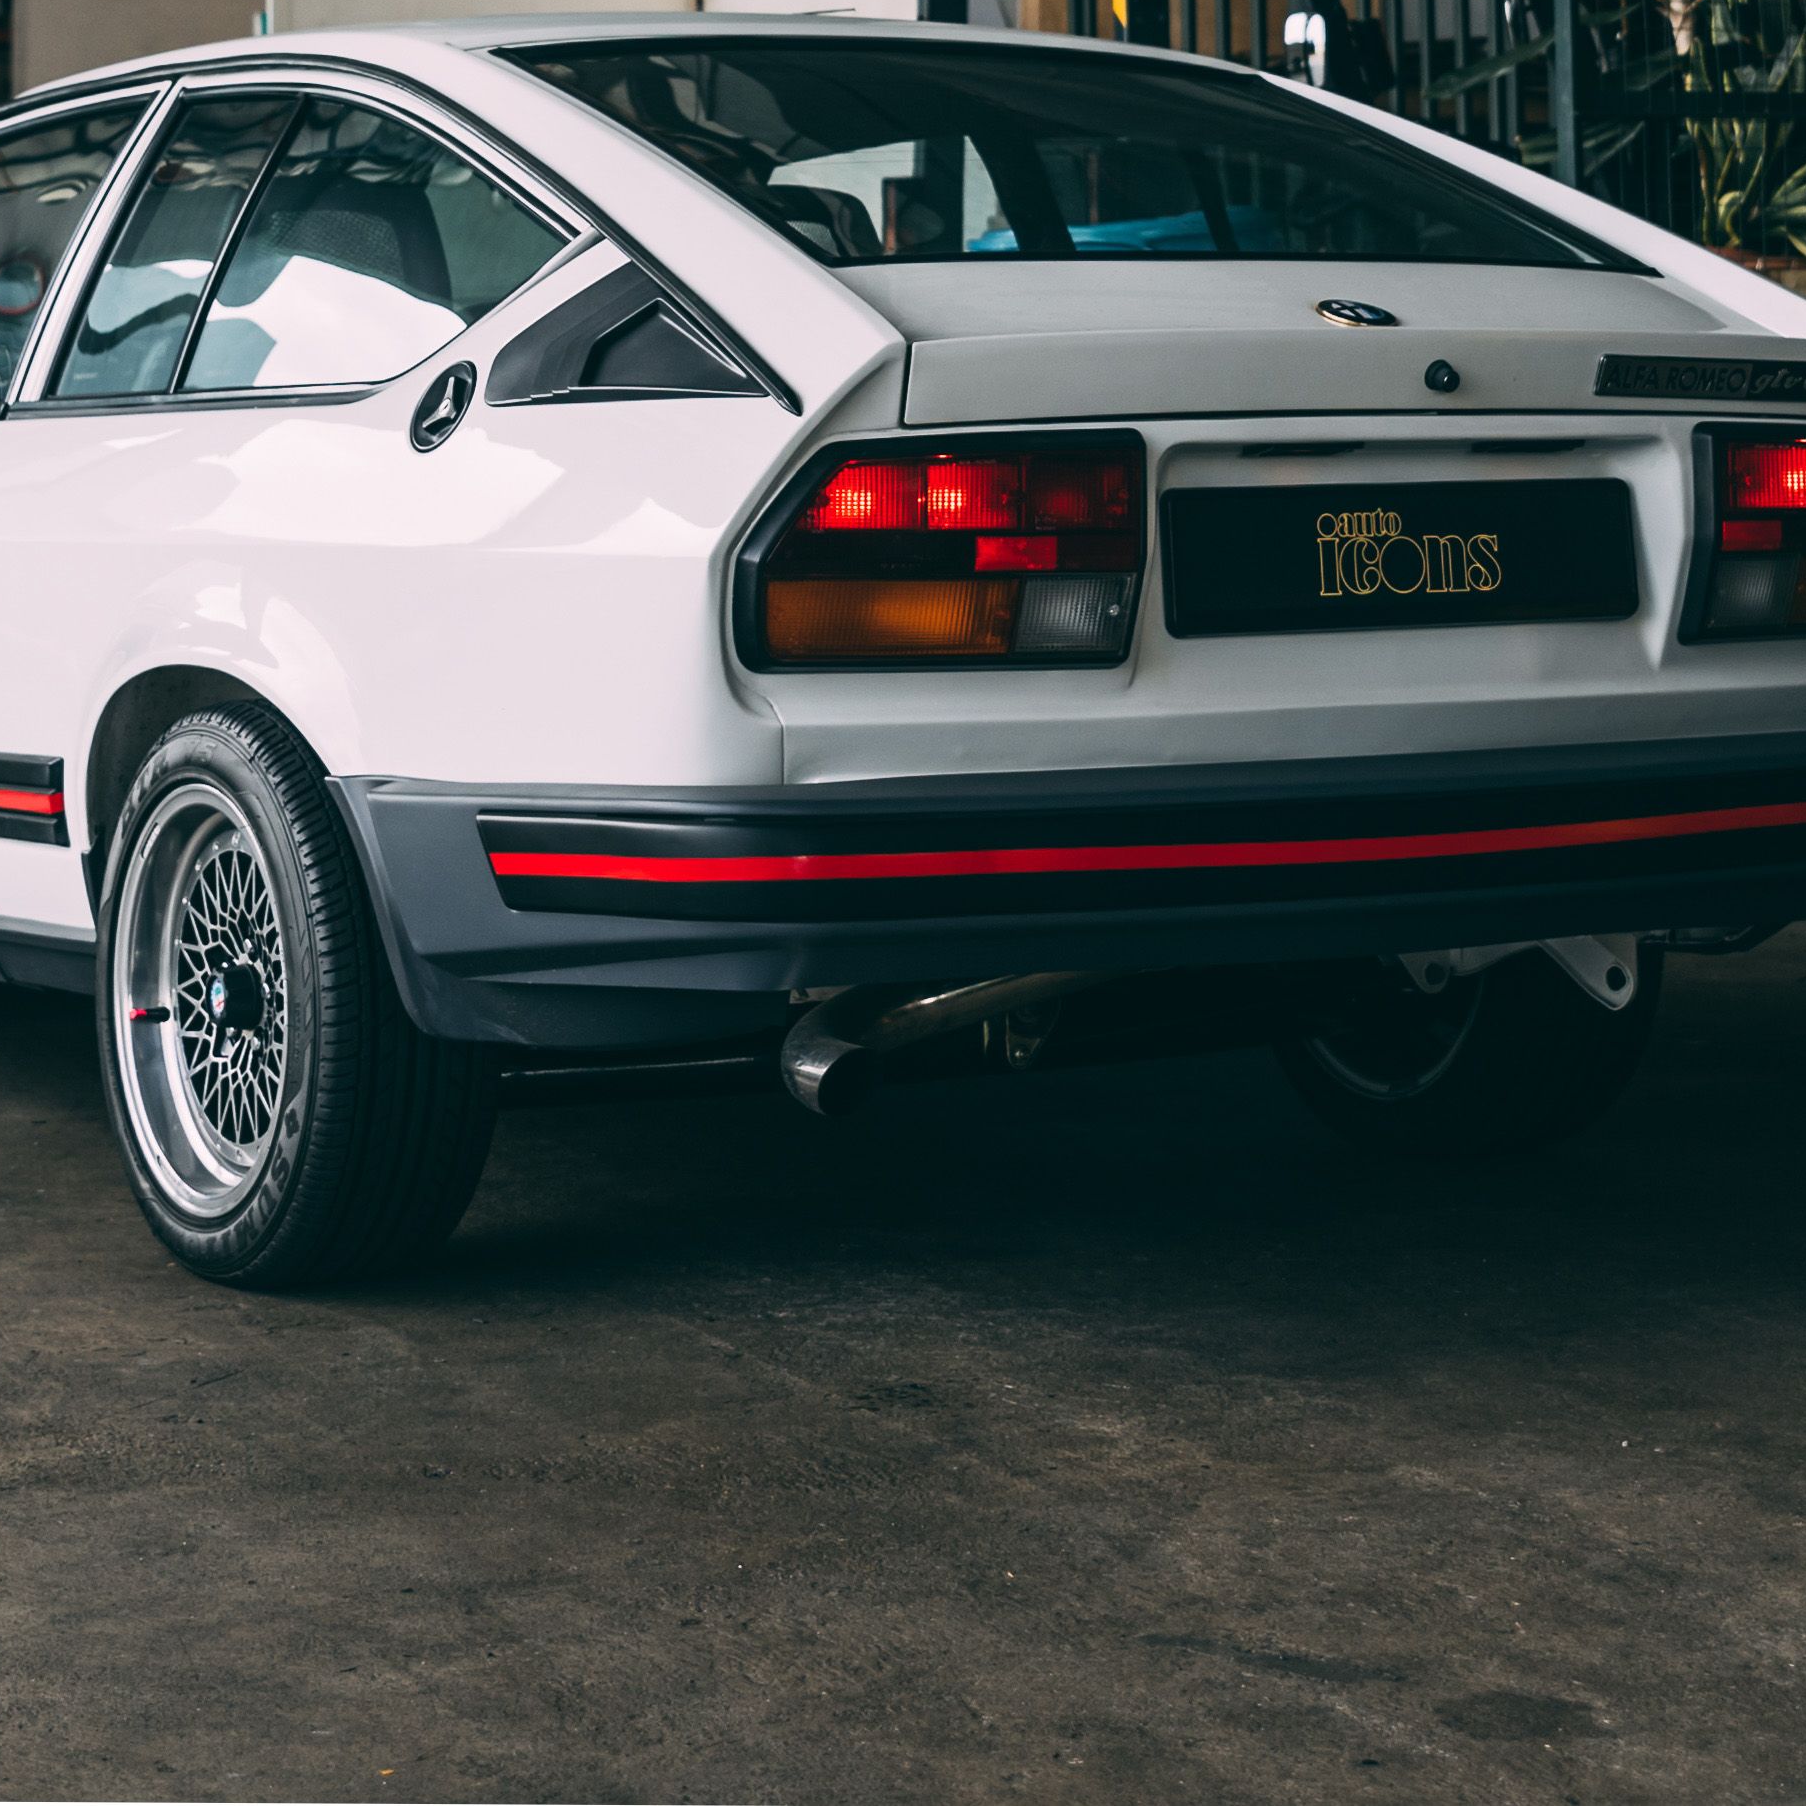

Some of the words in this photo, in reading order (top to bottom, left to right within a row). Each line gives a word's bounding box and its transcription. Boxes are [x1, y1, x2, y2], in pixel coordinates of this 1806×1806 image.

[1607, 363, 1660, 391] ALFA
[1665, 365, 1747, 394] ROMEO
[1337, 508, 1402, 538] auto
[1316, 513, 1502, 596] icons
